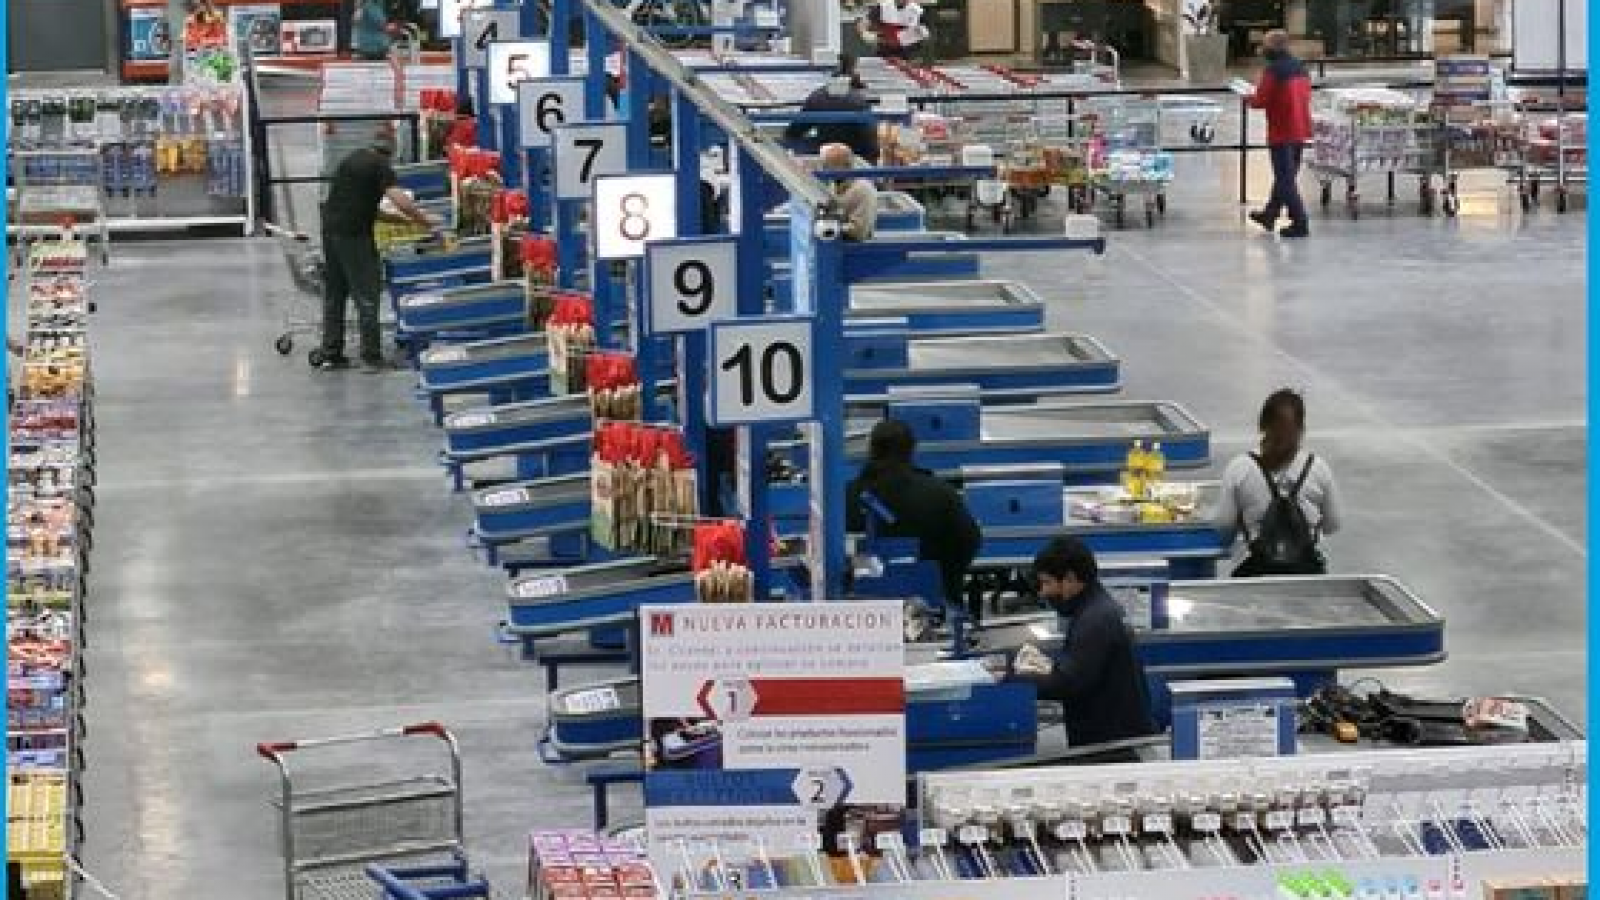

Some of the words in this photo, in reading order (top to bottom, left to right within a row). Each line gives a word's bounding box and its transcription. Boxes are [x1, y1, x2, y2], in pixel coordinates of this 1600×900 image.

[506, 53, 533, 90] 5
[535, 92, 566, 133] 6
[573, 139, 604, 183] 7
[619, 192, 652, 241] 8
[673, 259, 715, 316] 9
[721, 341, 804, 406] 10
[682, 615, 747, 632] NUEVA
[727, 690, 737, 712] 1
[811, 779, 826, 803] 2
